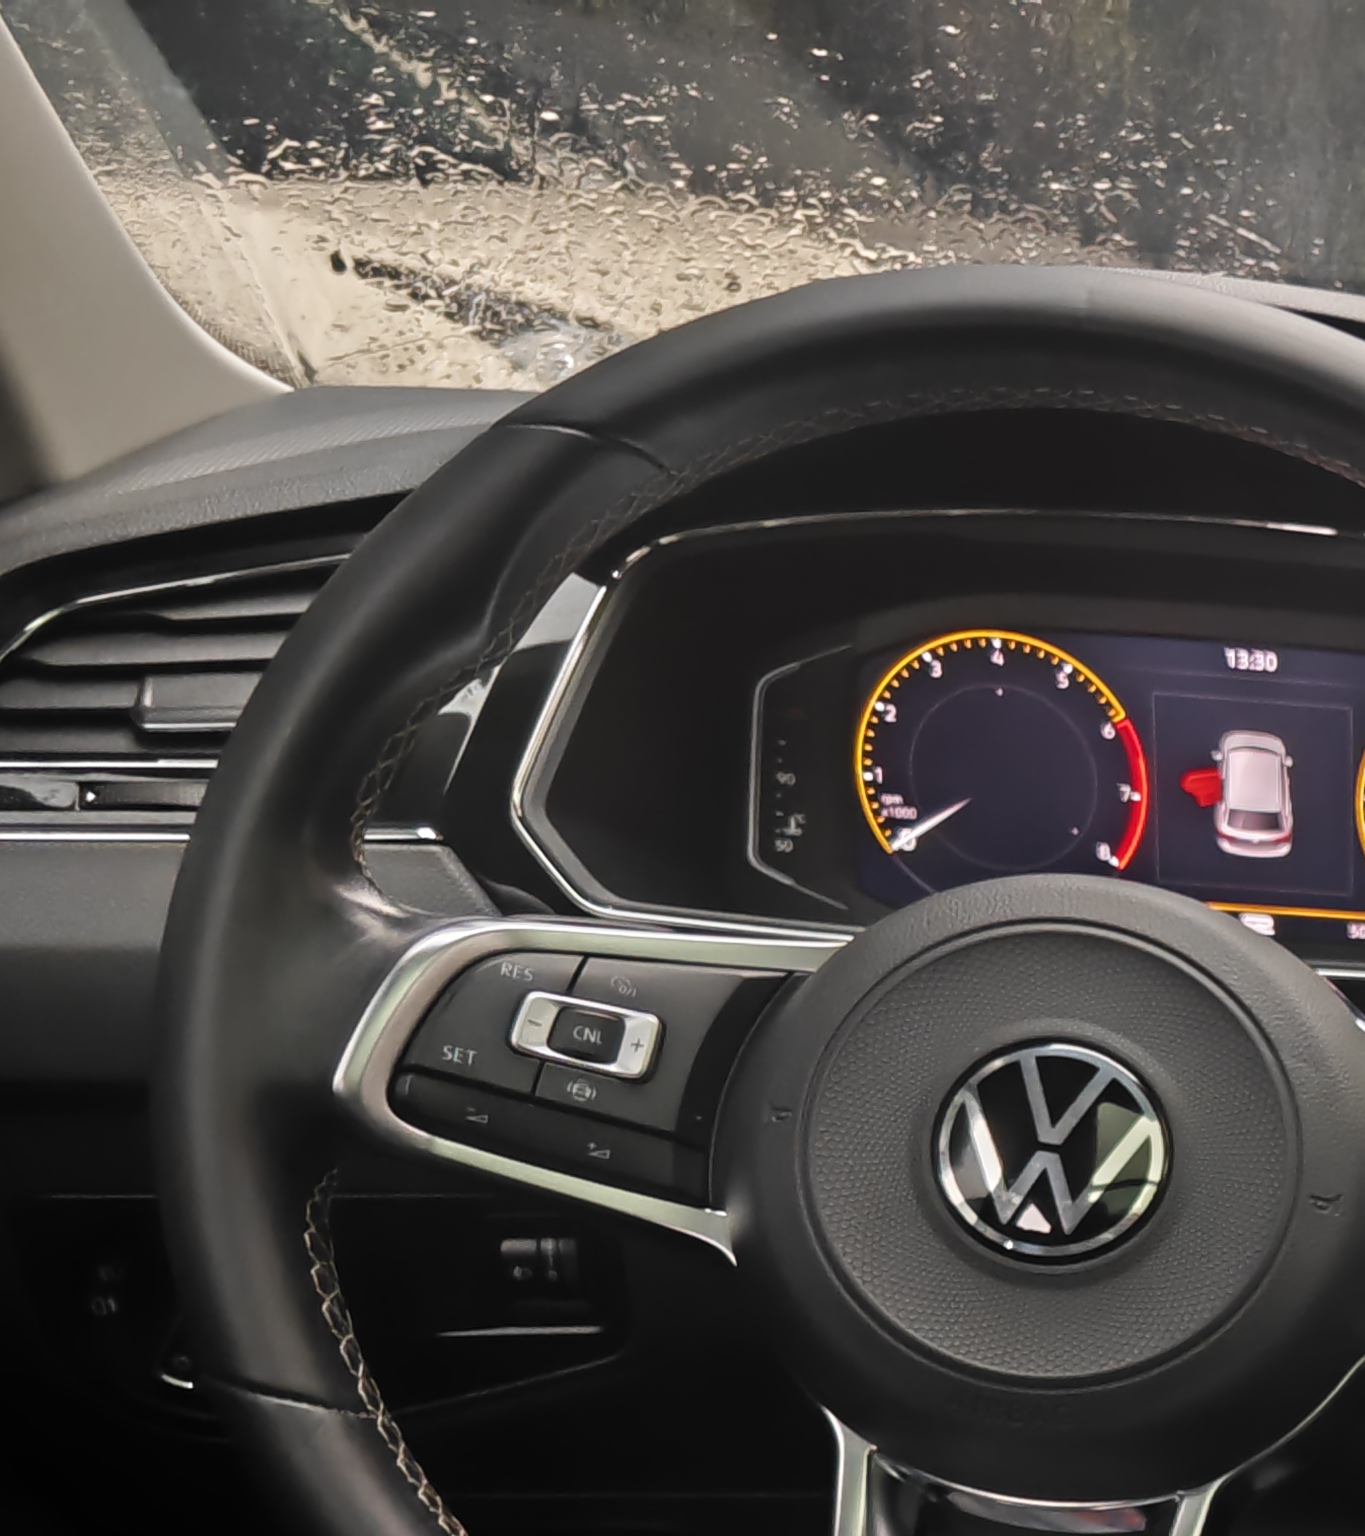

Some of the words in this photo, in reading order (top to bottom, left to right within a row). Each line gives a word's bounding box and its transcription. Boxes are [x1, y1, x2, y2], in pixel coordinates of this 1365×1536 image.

[991, 649, 1004, 666] 4
[931, 662, 942, 678] 3
[1055, 673, 1069, 689] 5
[884, 706, 897, 723] 2
[1101, 724, 1116, 740] 6
[873, 766, 883, 784] 1
[1117, 783, 1132, 802] 7
[500, 961, 534, 982] RES
[572, 1024, 603, 1045] CNL
[442, 1045, 477, 1066] SET
